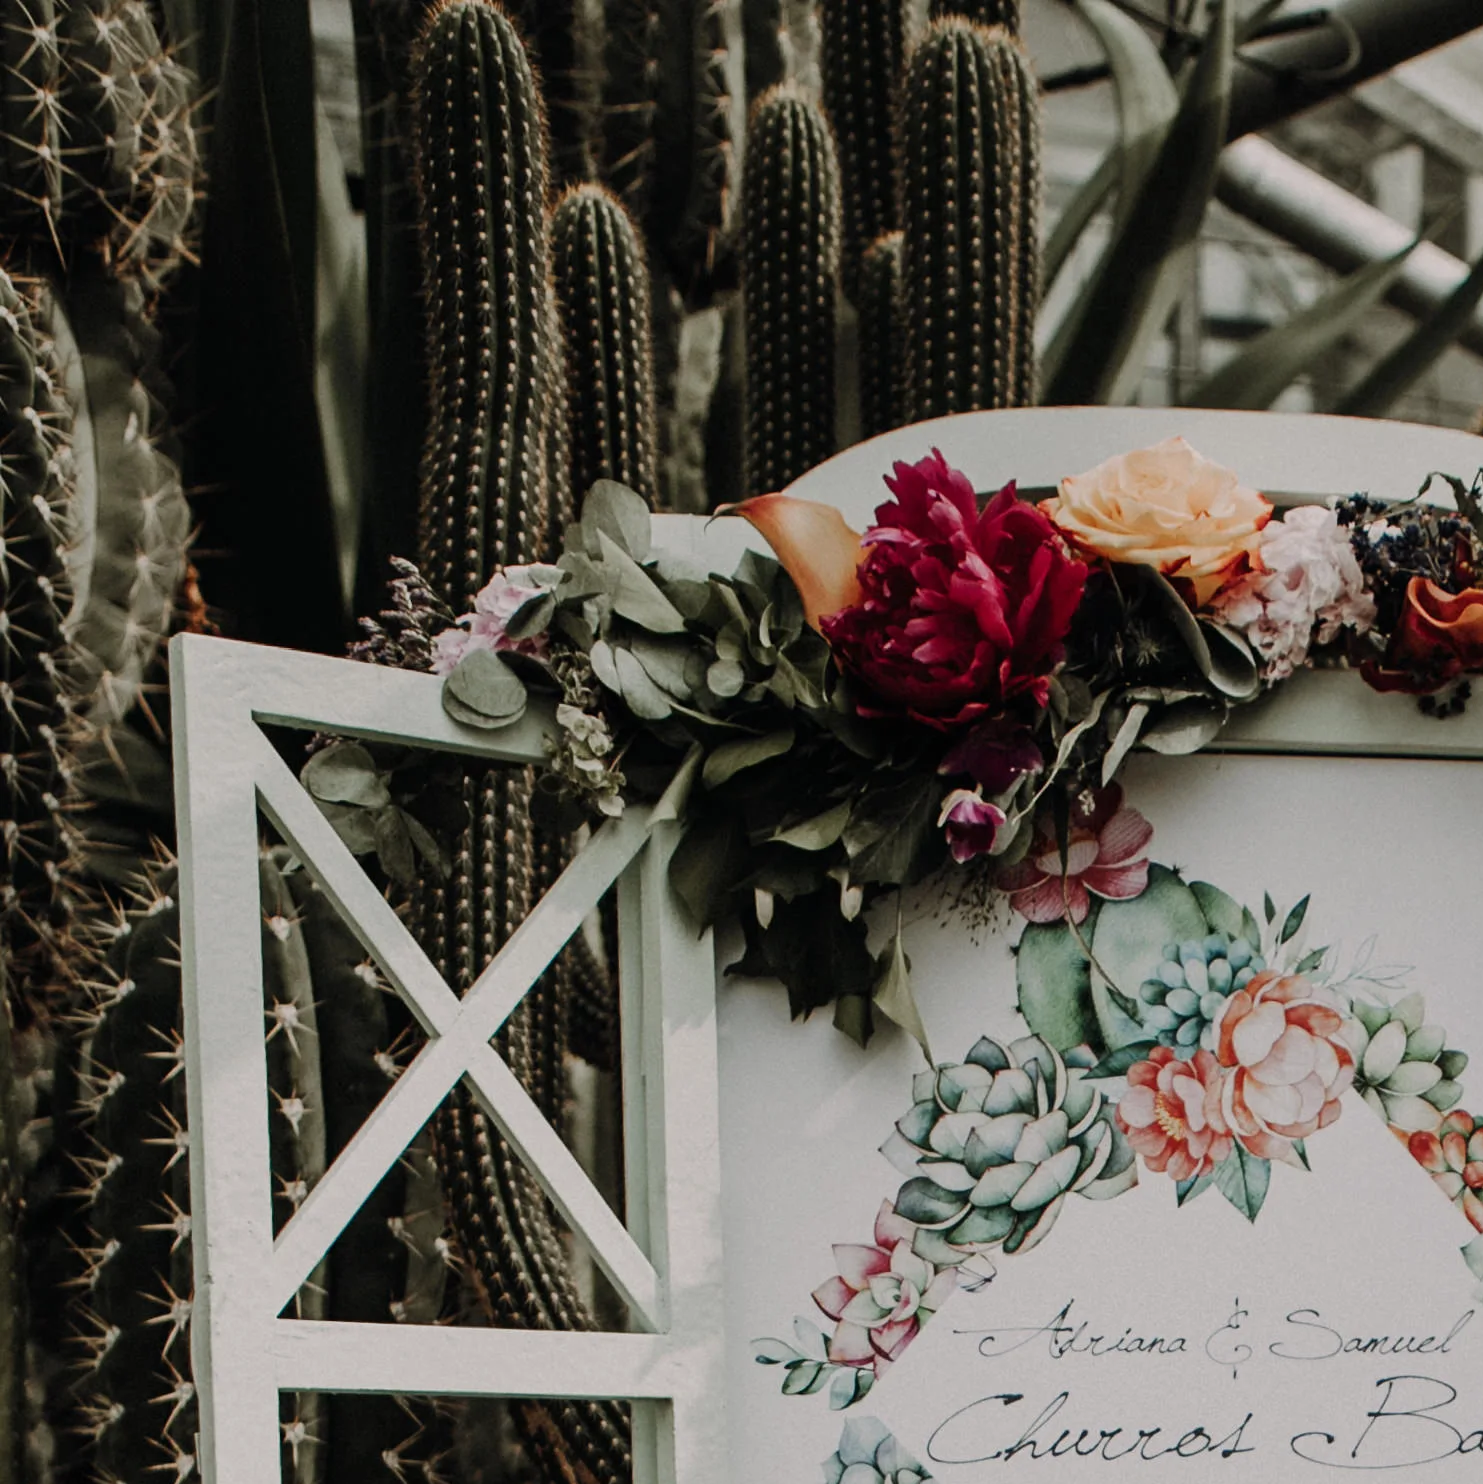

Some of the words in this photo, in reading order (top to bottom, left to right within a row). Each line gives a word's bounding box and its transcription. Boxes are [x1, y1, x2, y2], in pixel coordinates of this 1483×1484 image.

[953, 1297, 1187, 1358] Adriana
[1205, 1297, 1253, 1379] &
[1269, 1308, 1476, 1360] Samuel
[927, 1391, 1255, 1464] Churros
